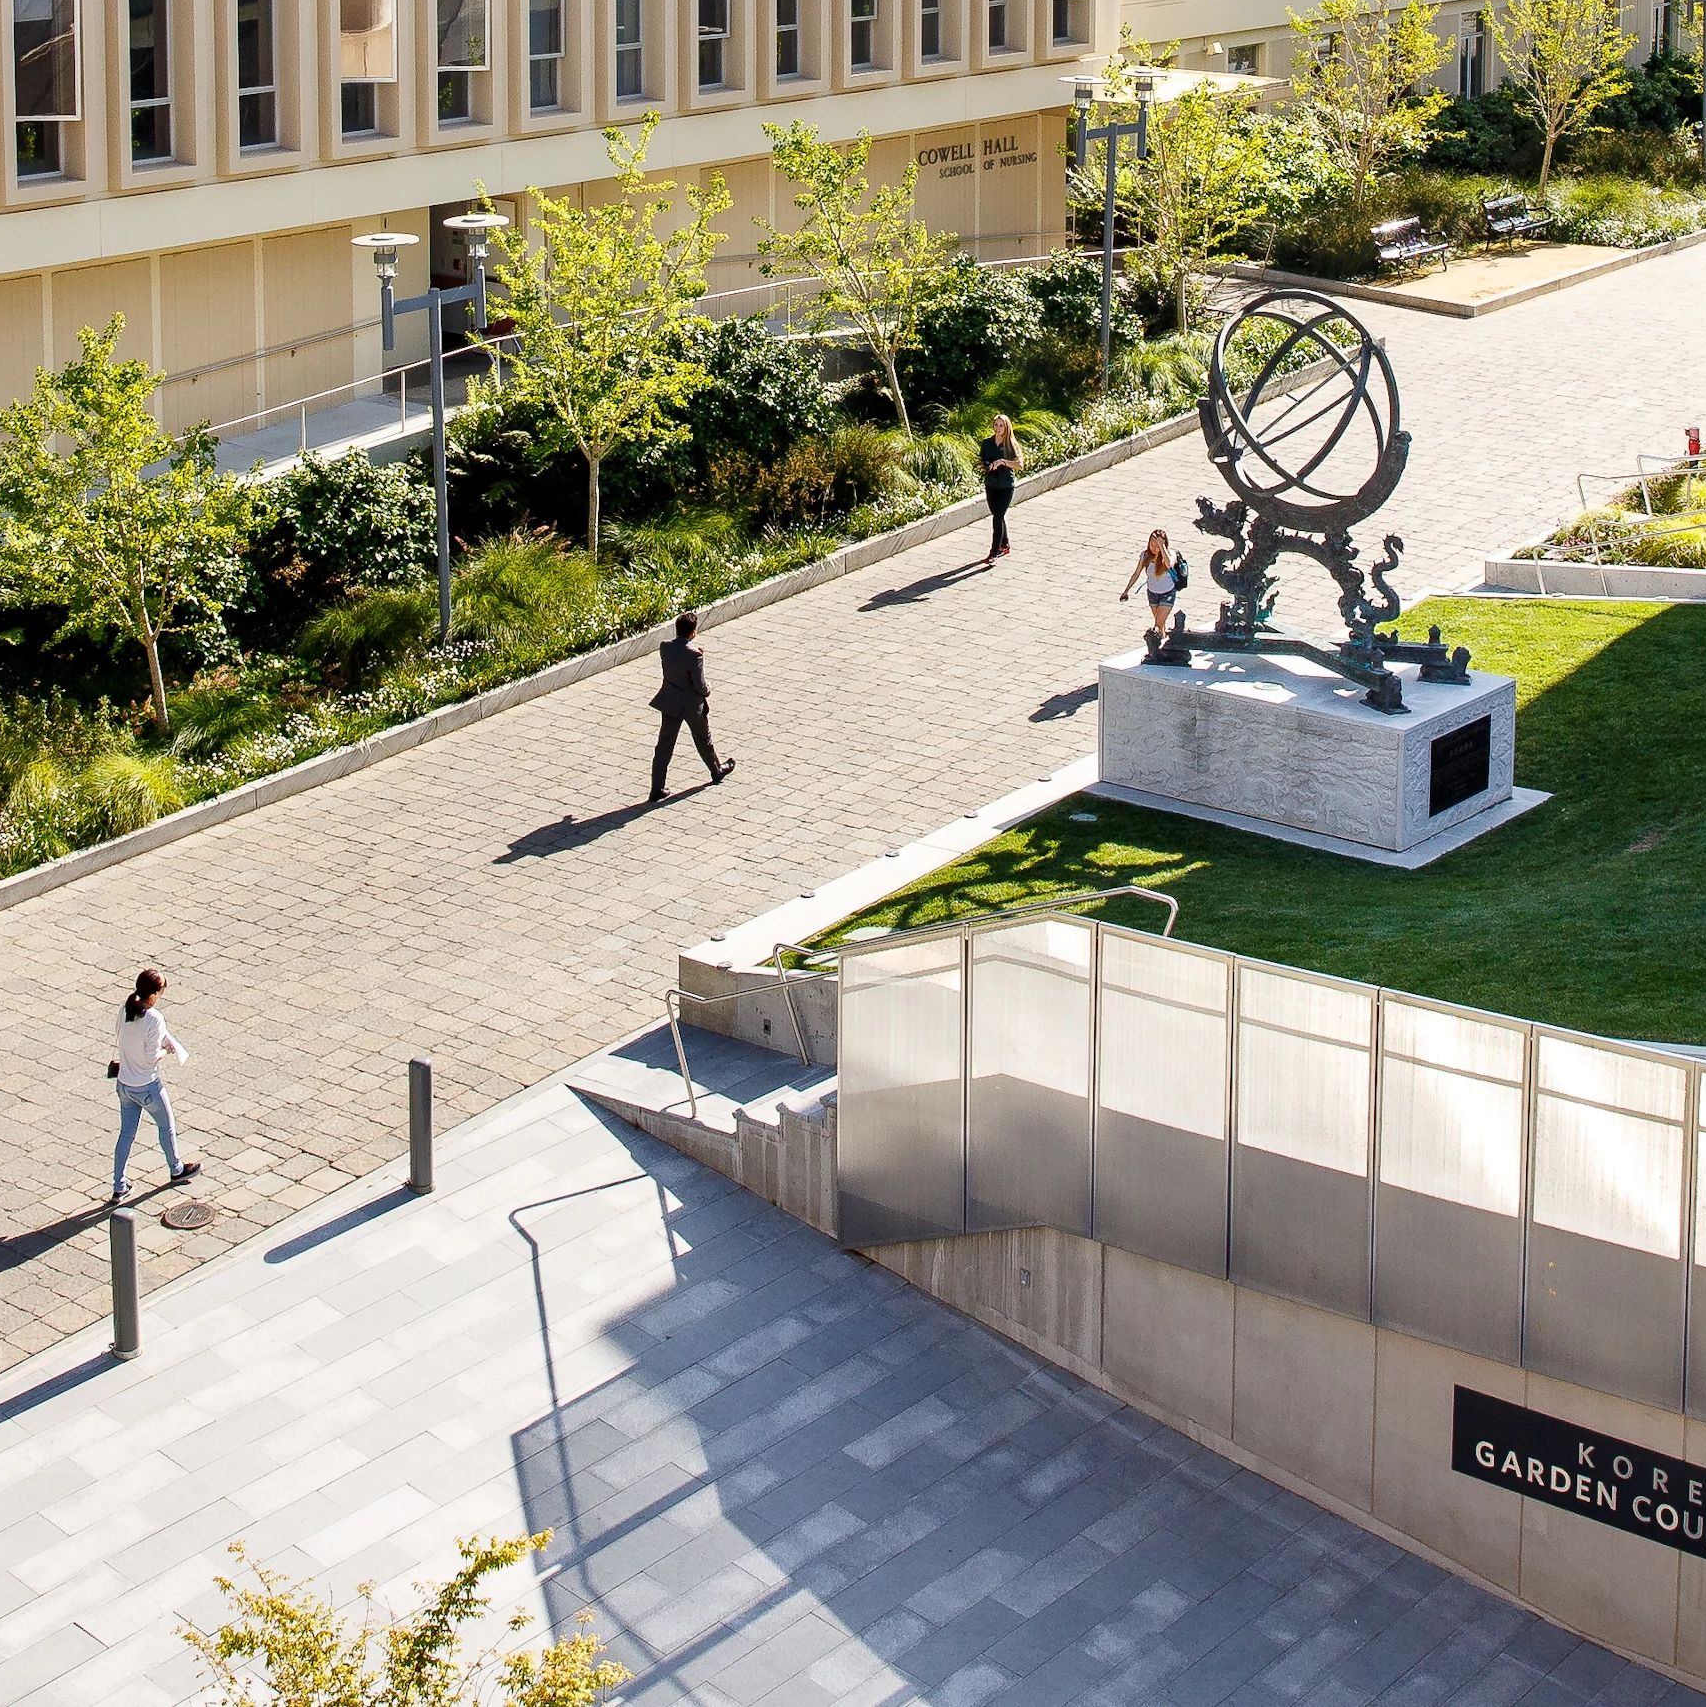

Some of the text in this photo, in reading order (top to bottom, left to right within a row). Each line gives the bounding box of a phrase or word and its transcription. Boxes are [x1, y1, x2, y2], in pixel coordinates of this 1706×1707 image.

[918, 136, 1018, 166] COWELL HALL
[939, 152, 1037, 179] SCHOOL OF NURSING
[1475, 1440, 1618, 1511] GARDEN
